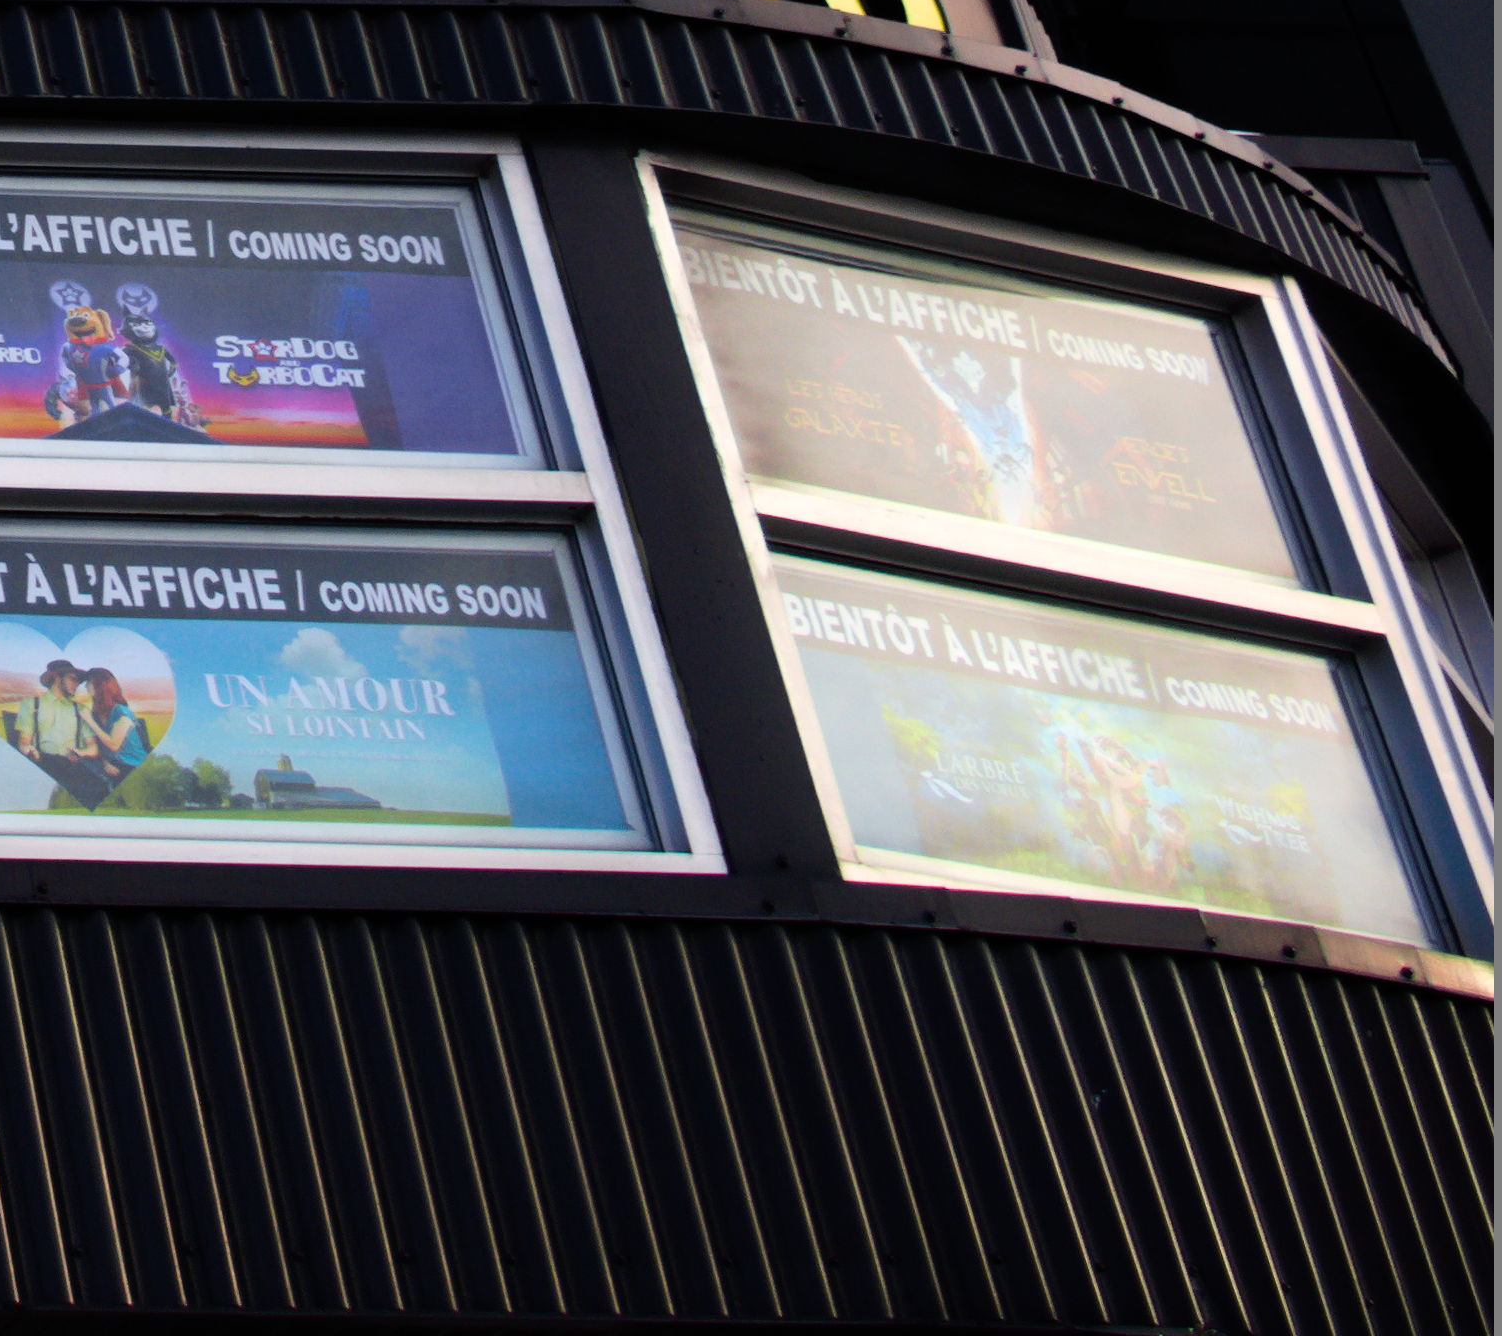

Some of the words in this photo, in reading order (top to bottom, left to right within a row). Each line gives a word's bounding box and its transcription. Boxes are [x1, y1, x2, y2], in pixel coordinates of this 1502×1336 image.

[228, 230, 353, 262] COMING
[360, 233, 446, 266] SOON
[681, 245, 824, 309] BIENTÔT
[829, 268, 859, 318] À
[857, 284, 1028, 349] L'AFFICHE
[1047, 329, 1145, 371] COMING
[1145, 347, 1209, 386] SOON
[25, 552, 57, 605] À
[63, 563, 286, 611] L'AFFICHE
[319, 580, 450, 614] COMING
[456, 583, 548, 620] SOON
[782, 592, 935, 658] BIENTÔT
[941, 613, 973, 667] À
[971, 629, 1149, 699] L'AFFICHE
[1165, 677, 1269, 719] COMING
[1269, 693, 1339, 733] SOON
[203, 673, 272, 709] UN
[286, 676, 457, 717] AMOUR
[246, 714, 275, 736] SI
[286, 716, 427, 741] LOINTAIN
